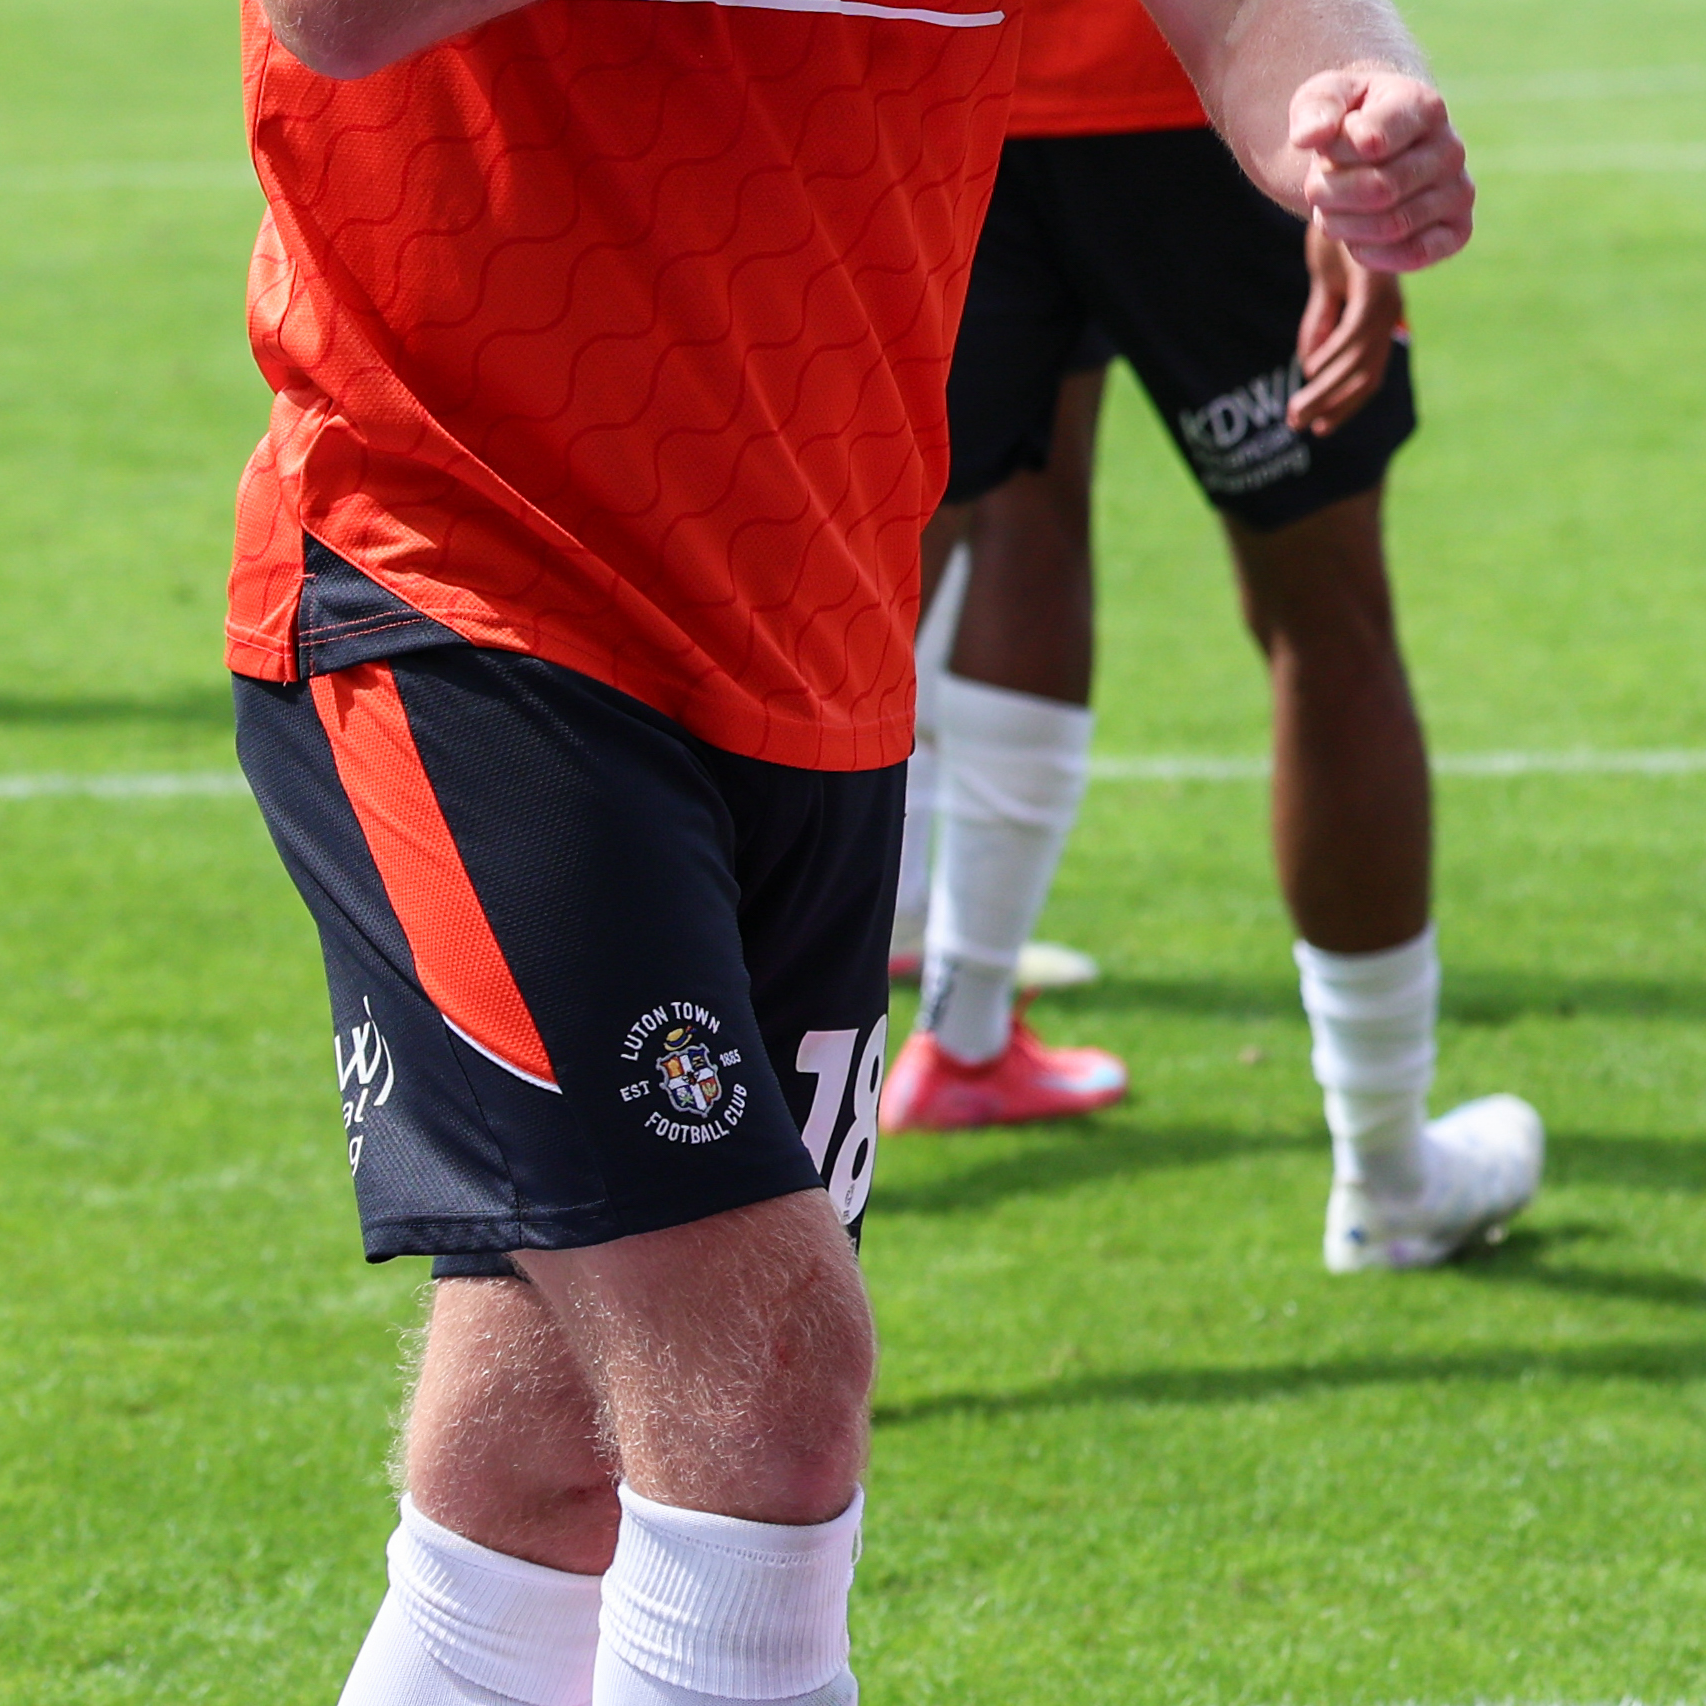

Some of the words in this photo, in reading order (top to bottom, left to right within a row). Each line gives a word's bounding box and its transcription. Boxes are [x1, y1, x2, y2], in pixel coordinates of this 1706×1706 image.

[620, 1005, 670, 1062] LUTON
[670, 1001, 721, 1035] TOWN
[619, 1080, 651, 1103] EST
[723, 1082, 748, 1126] CLUB
[644, 1111, 731, 1145] FOOTBALL
[795, 1013, 888, 1226] 18
